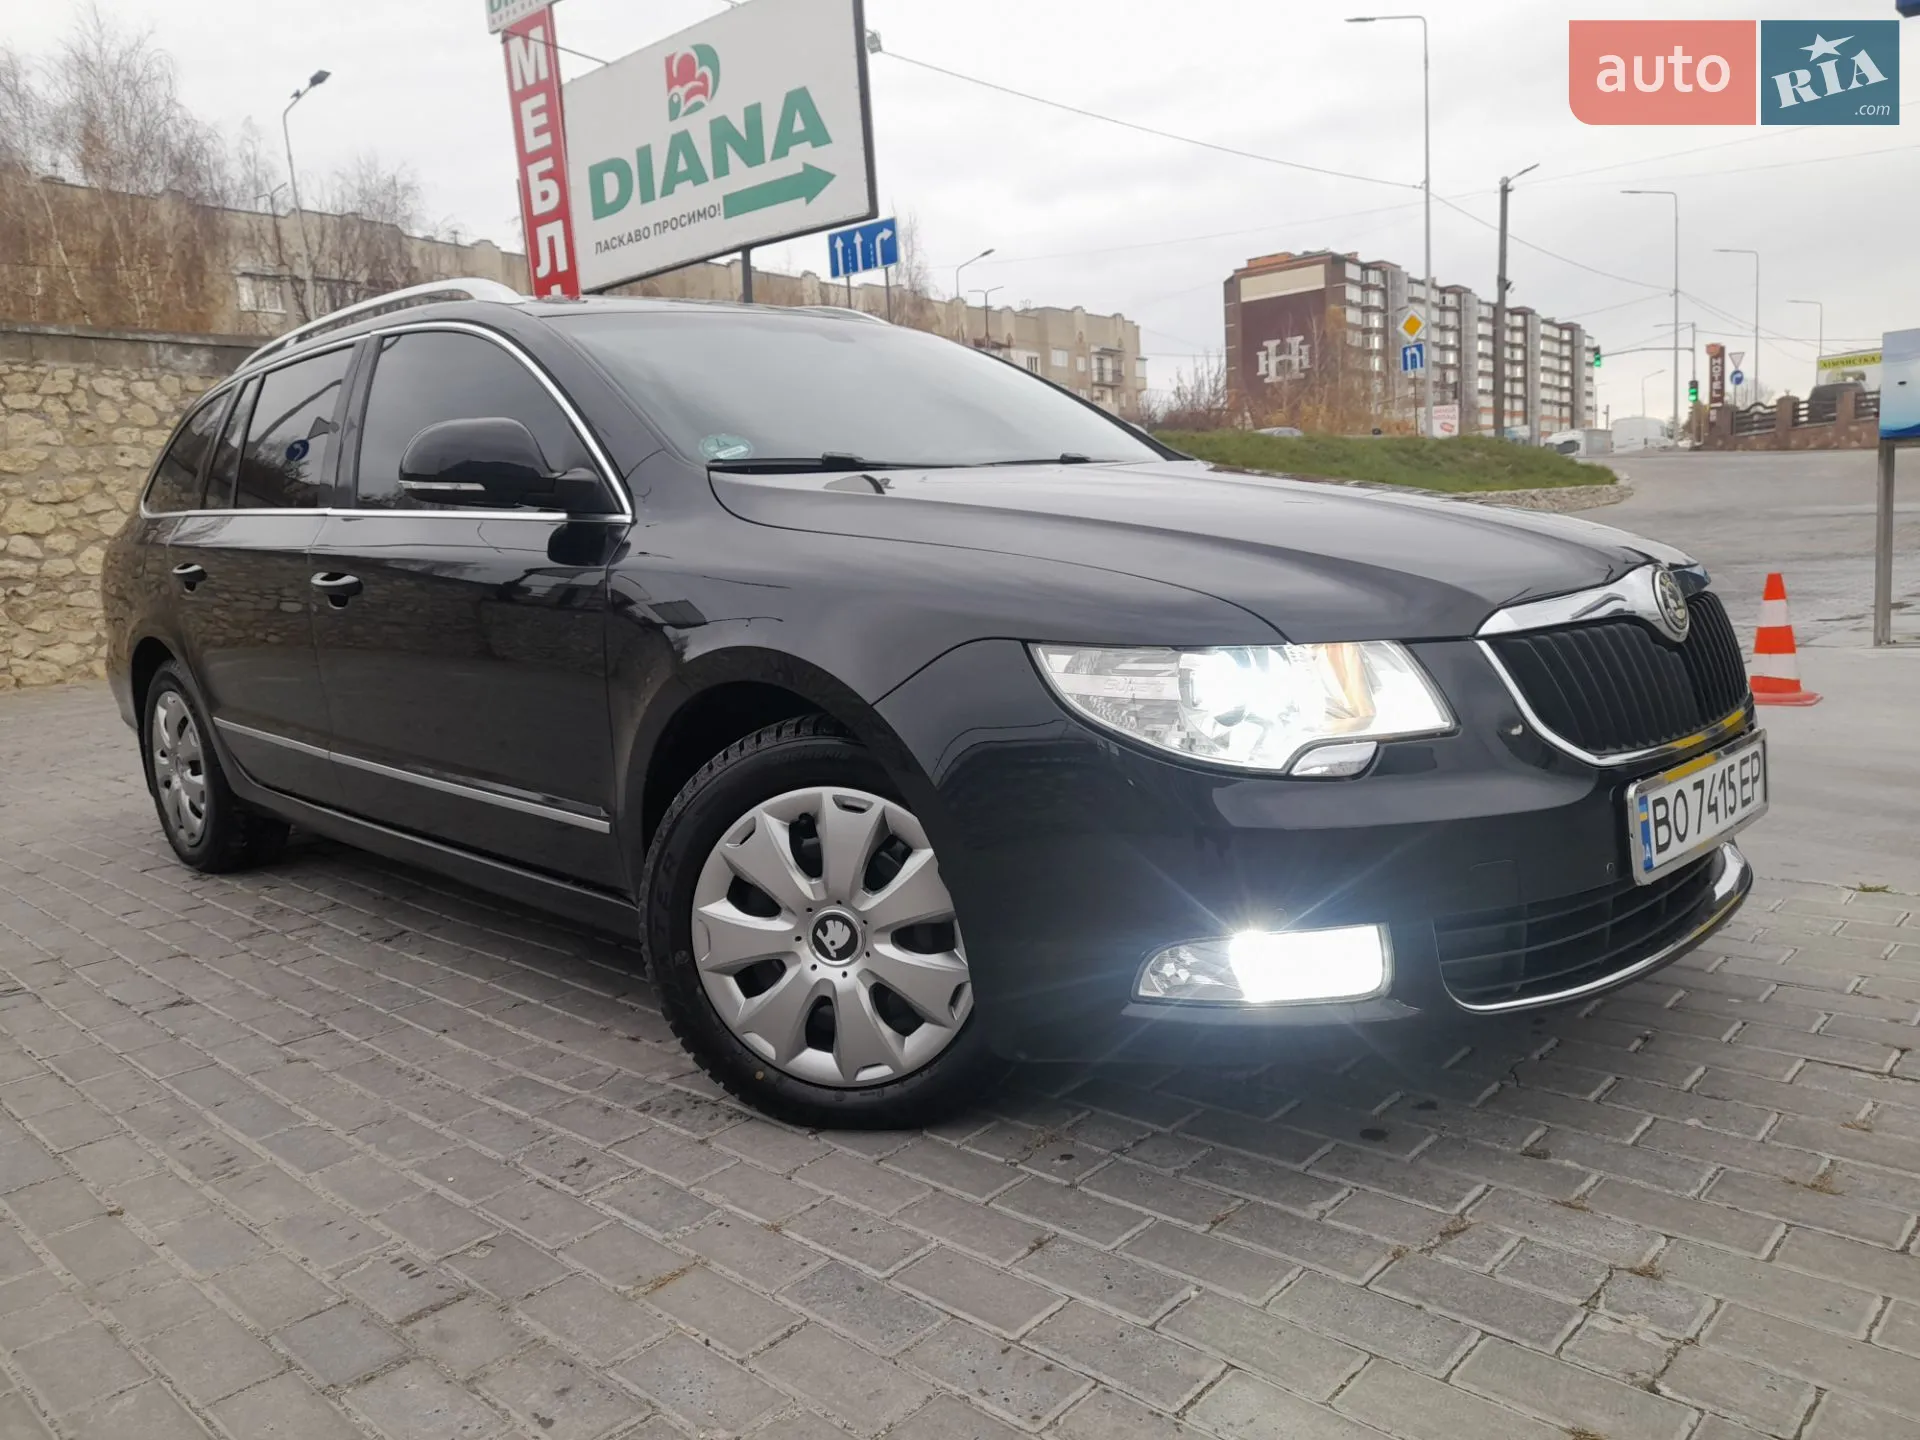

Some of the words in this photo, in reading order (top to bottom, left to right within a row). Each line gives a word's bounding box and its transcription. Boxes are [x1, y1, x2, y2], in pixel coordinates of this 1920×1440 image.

[507, 24, 569, 299] МЕБЛ
[588, 85, 833, 221] DIANA
[594, 226, 651, 255] ЛАСКАВО
[652, 202, 722, 237] ПРОСИМО!
[1711, 357, 1723, 398] HOTEL
[1652, 788, 1689, 855] BO
[1692, 763, 1738, 835] 7415
[1739, 750, 1761, 809] EP
